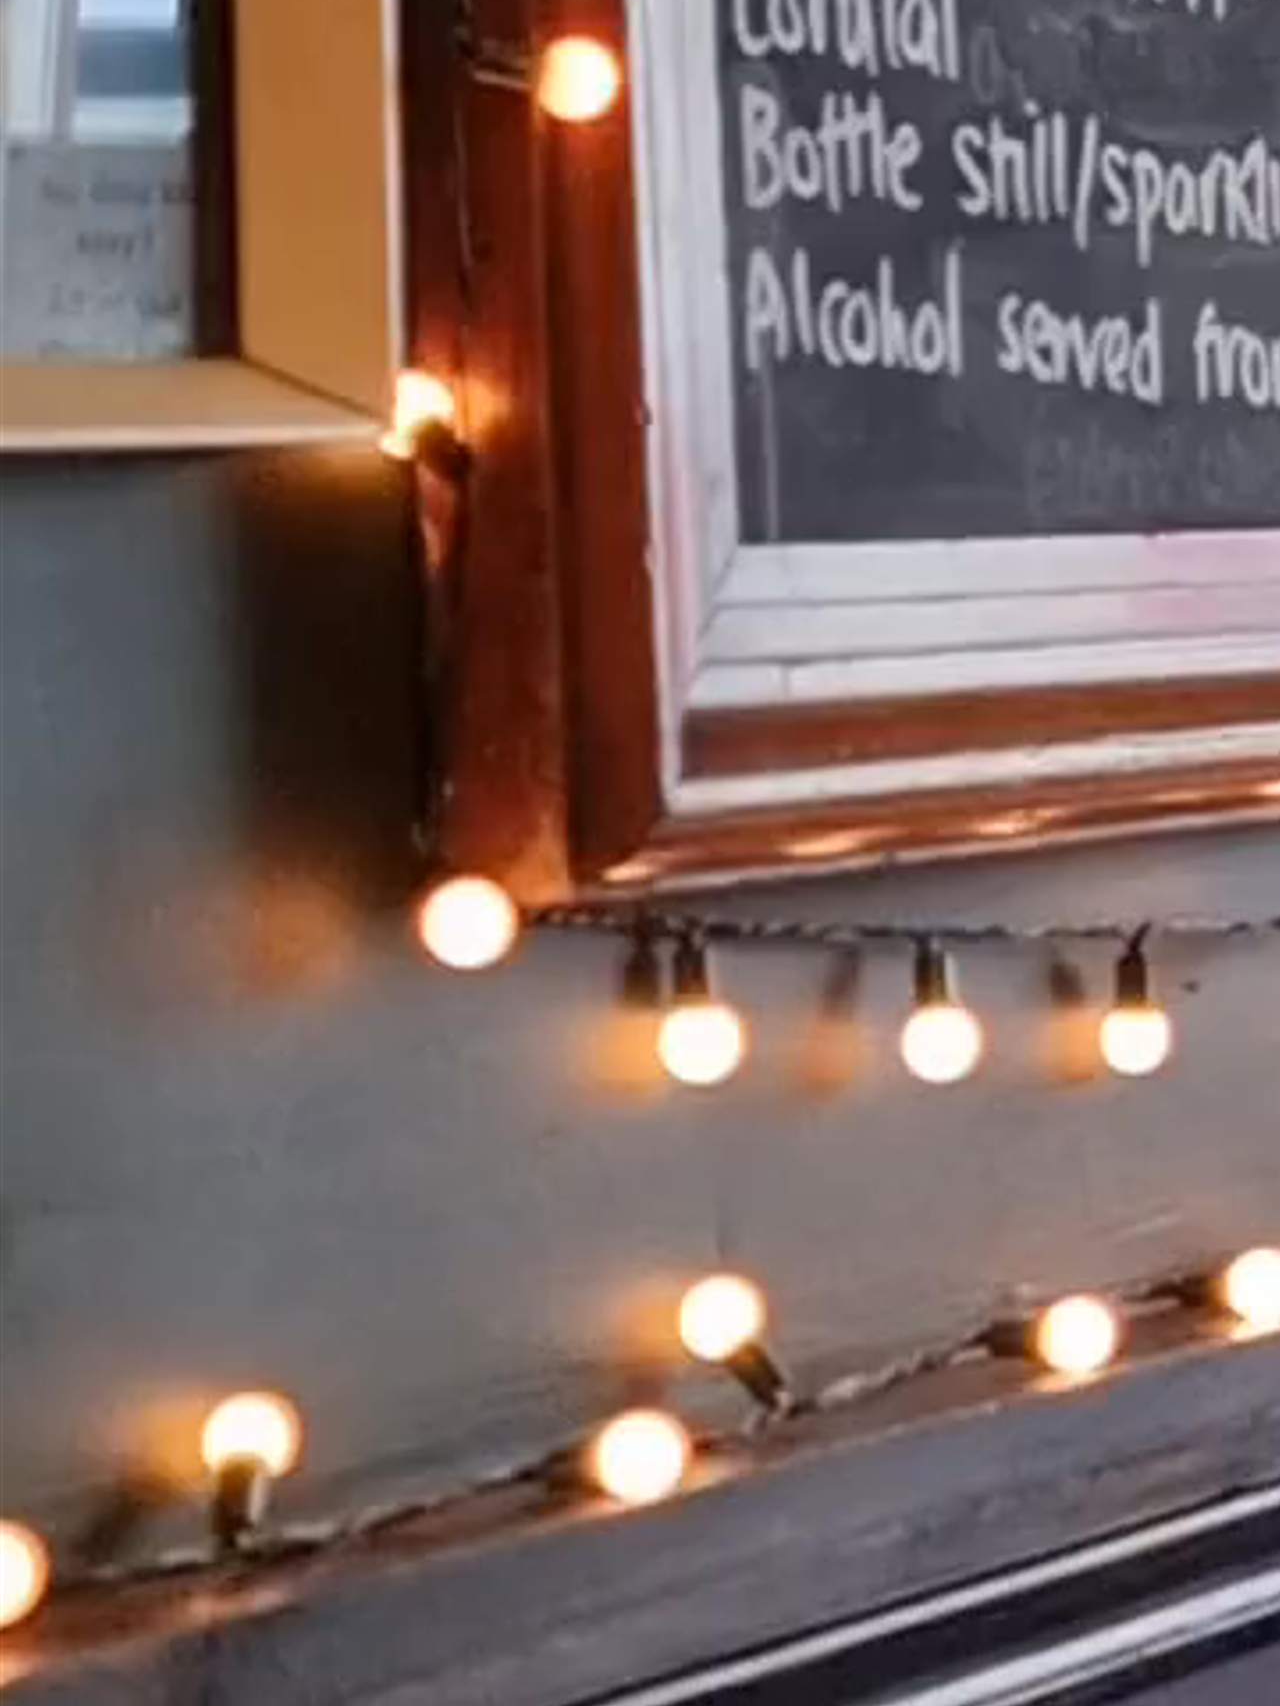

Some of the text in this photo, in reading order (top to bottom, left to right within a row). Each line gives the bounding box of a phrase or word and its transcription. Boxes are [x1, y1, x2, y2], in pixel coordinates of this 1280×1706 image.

[740, 85, 922, 210] Bottle
[745, 248, 963, 374] Alcohol
[997, 295, 1163, 402] served
